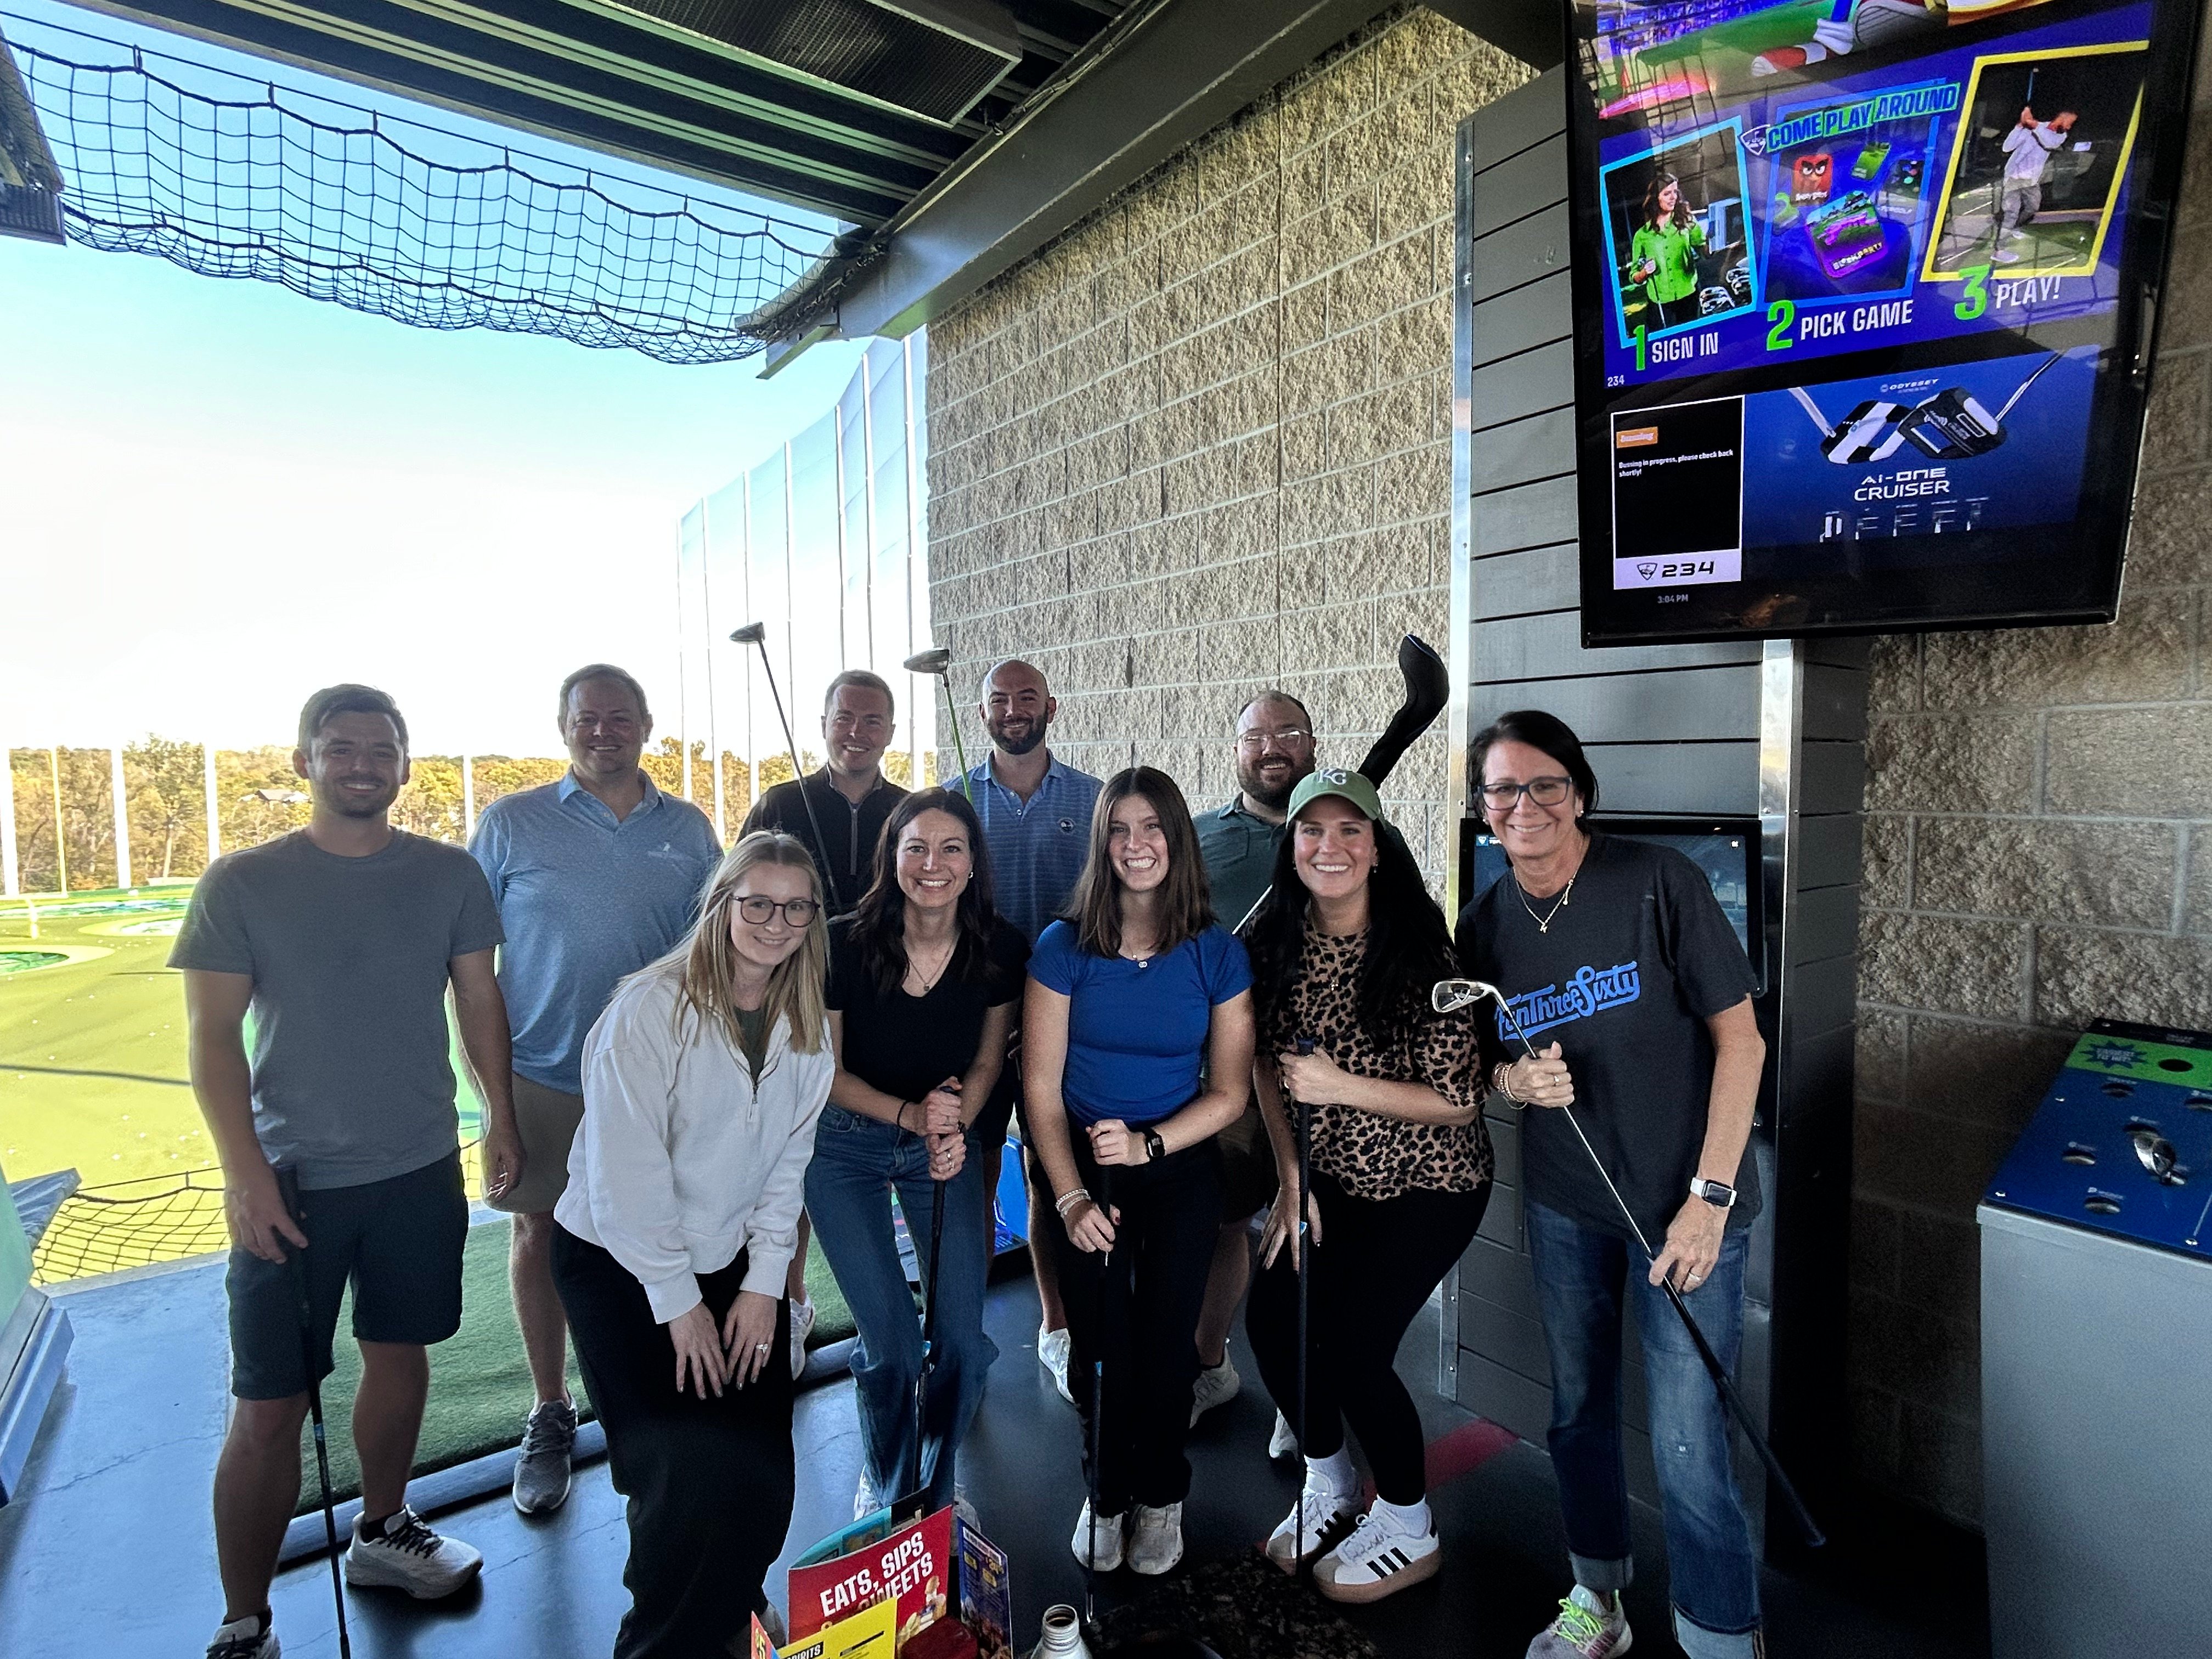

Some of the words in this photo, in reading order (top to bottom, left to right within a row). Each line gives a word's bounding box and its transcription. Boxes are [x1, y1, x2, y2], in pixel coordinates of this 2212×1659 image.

[1768, 113, 1822, 149] COME
[1825, 103, 1872, 135] PLAY
[1874, 86, 1958, 120] AROUND
[1954, 264, 1990, 320] 3
[1996, 275, 2061, 309] PLAY!
[1633, 324, 1645, 371] 1
[1651, 336, 1694, 363] SIGN
[1700, 332, 1718, 357] IN
[1766, 299, 1795, 351] 2
[1801, 311, 1847, 341] PICK
[1853, 300, 1914, 332] GAME
[1607, 375, 1625, 387] 234
[1854, 480, 1950, 501] CRUISER
[1661, 561, 1714, 578] 234
[1657, 595, 1674, 603] 3:04
[820, 1568, 879, 1617] EATS,
[881, 1531, 924, 1579] SIPS
